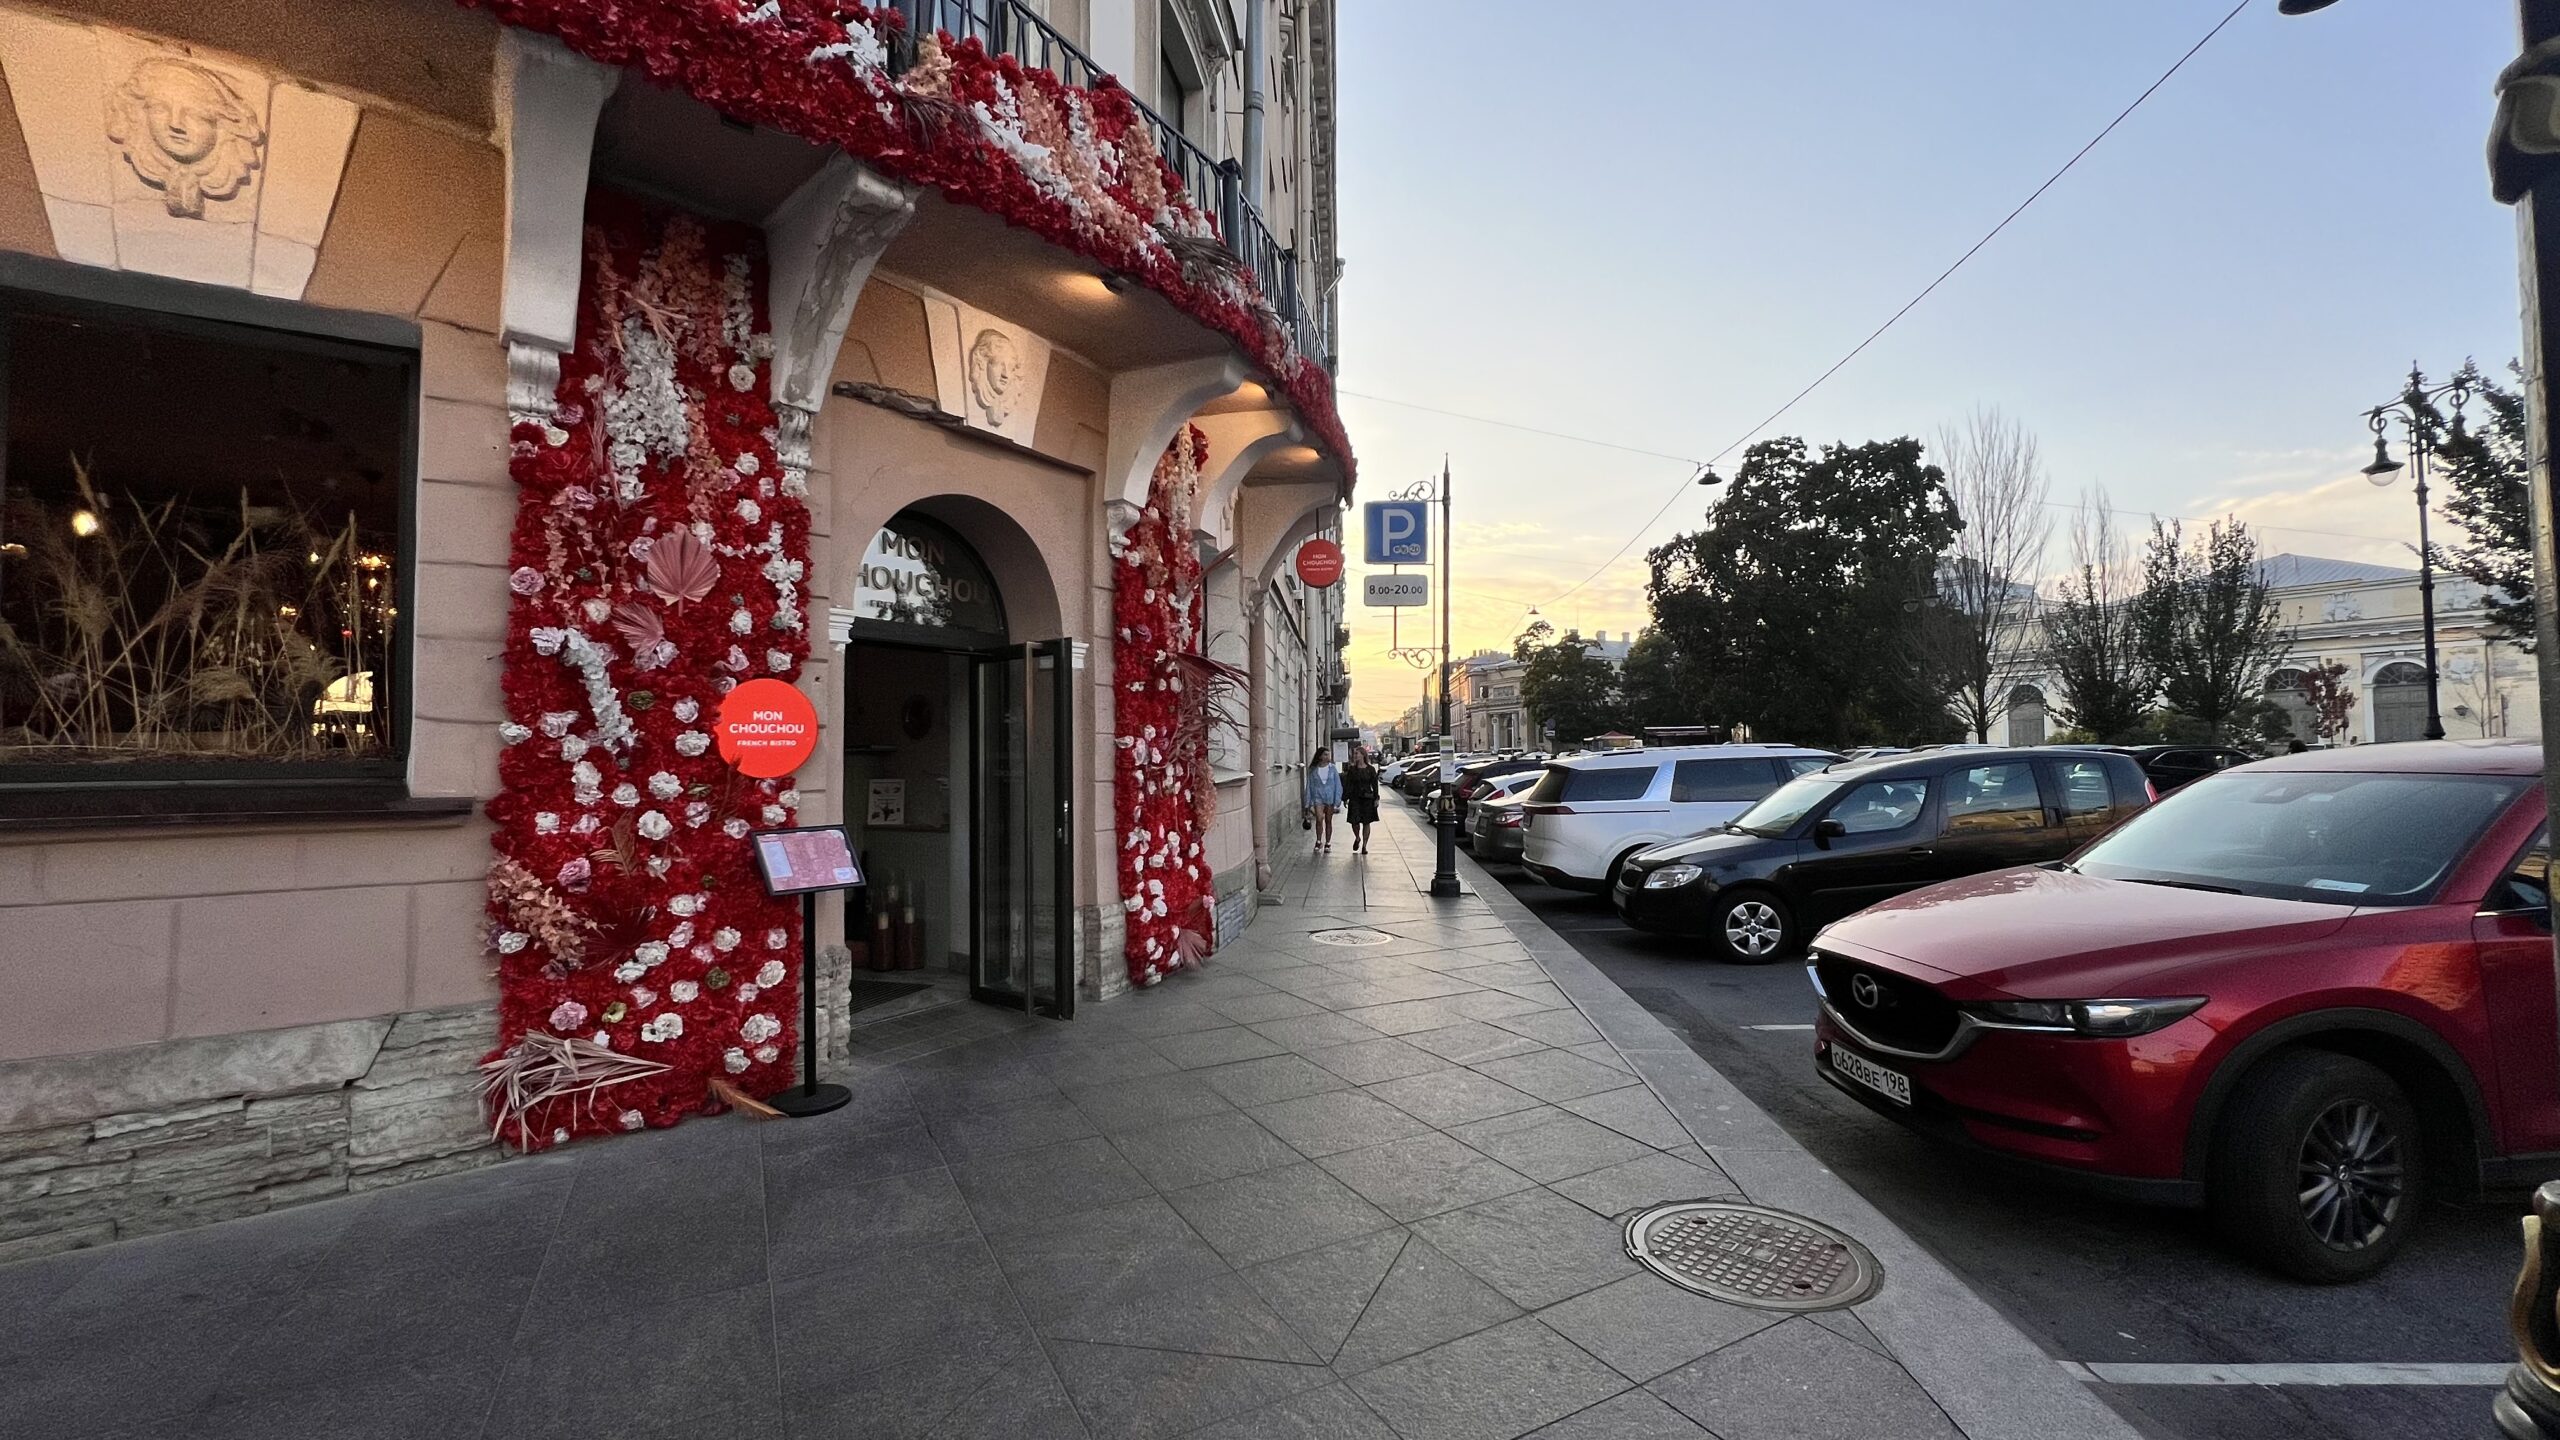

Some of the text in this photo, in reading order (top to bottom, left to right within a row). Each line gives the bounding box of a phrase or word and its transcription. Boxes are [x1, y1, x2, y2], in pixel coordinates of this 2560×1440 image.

[1382, 508, 1416, 557] P
[881, 531, 945, 565] MON
[753, 710, 783, 721] MON
[729, 723, 805, 734] CHOUCHOU
[1882, 1071, 1906, 1093] 198
